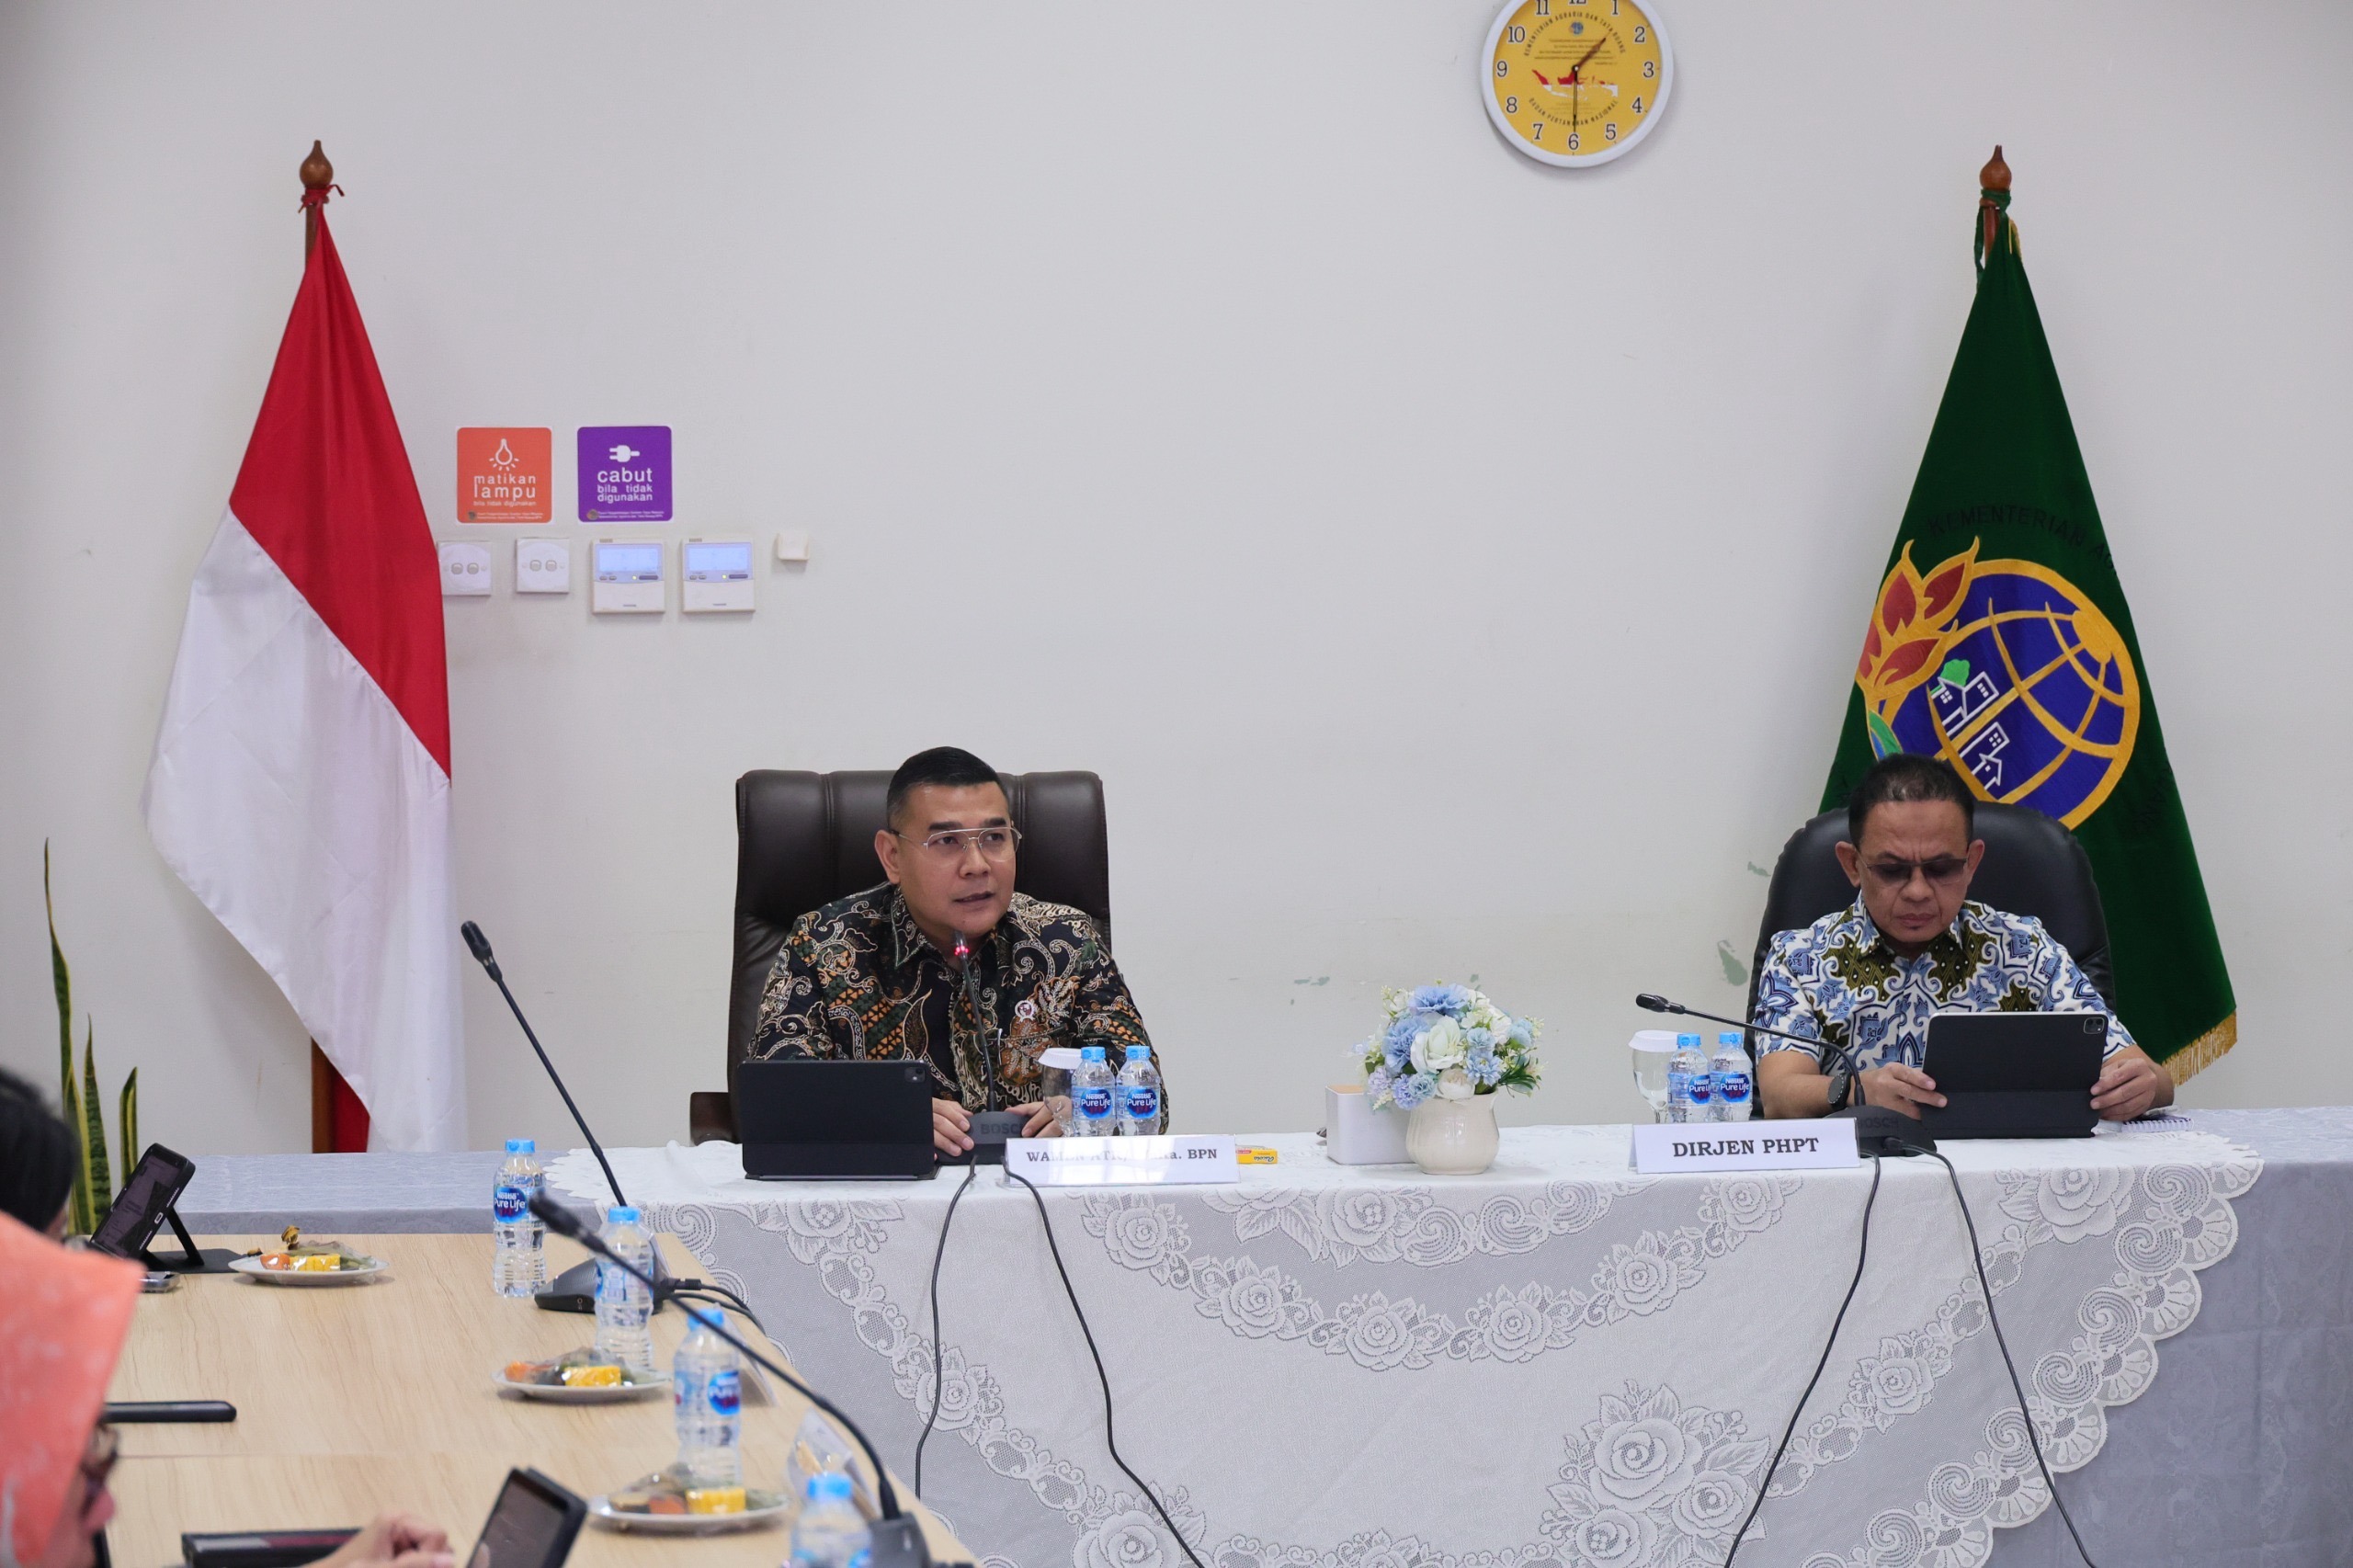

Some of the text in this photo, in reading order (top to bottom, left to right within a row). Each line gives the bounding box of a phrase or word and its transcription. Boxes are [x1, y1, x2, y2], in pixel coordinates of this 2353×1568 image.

[1536, 0, 1550, 15] 11
[1612, 0, 1619, 15] 1
[1508, 26, 1526, 43] 10
[1524, 11, 1626, 56] KEMENTERIAN AGRARIA DAN TATA RUANG
[1634, 27, 1645, 43] 2
[1497, 61, 1507, 77] 9
[1643, 62, 1654, 78] 3
[1506, 97, 1518, 113] 8
[1631, 97, 1643, 113] 4
[1533, 123, 1543, 140] 7
[1605, 123, 1616, 140] 5
[1568, 134, 1579, 150] 6
[473, 473, 537, 484] matikan
[597, 467, 653, 483] cabut
[473, 483, 536, 501] lampu
[597, 483, 653, 493] bila tidak
[597, 494, 654, 504] digunakan
[1927, 504, 2086, 547] KEMENTERIAN
[1738, 1084, 1750, 1093] Life
[1081, 1098, 1111, 1108] Pure Life
[1127, 1098, 1156, 1108] Pure Life
[981, 1123, 1022, 1134] BOSC
[1672, 1137, 1820, 1157] DIRJEN PHPT
[1026, 1151, 1085, 1163] WAMN
[1188, 1148, 1218, 1160] BPN
[510, 1199, 526, 1211] Life
